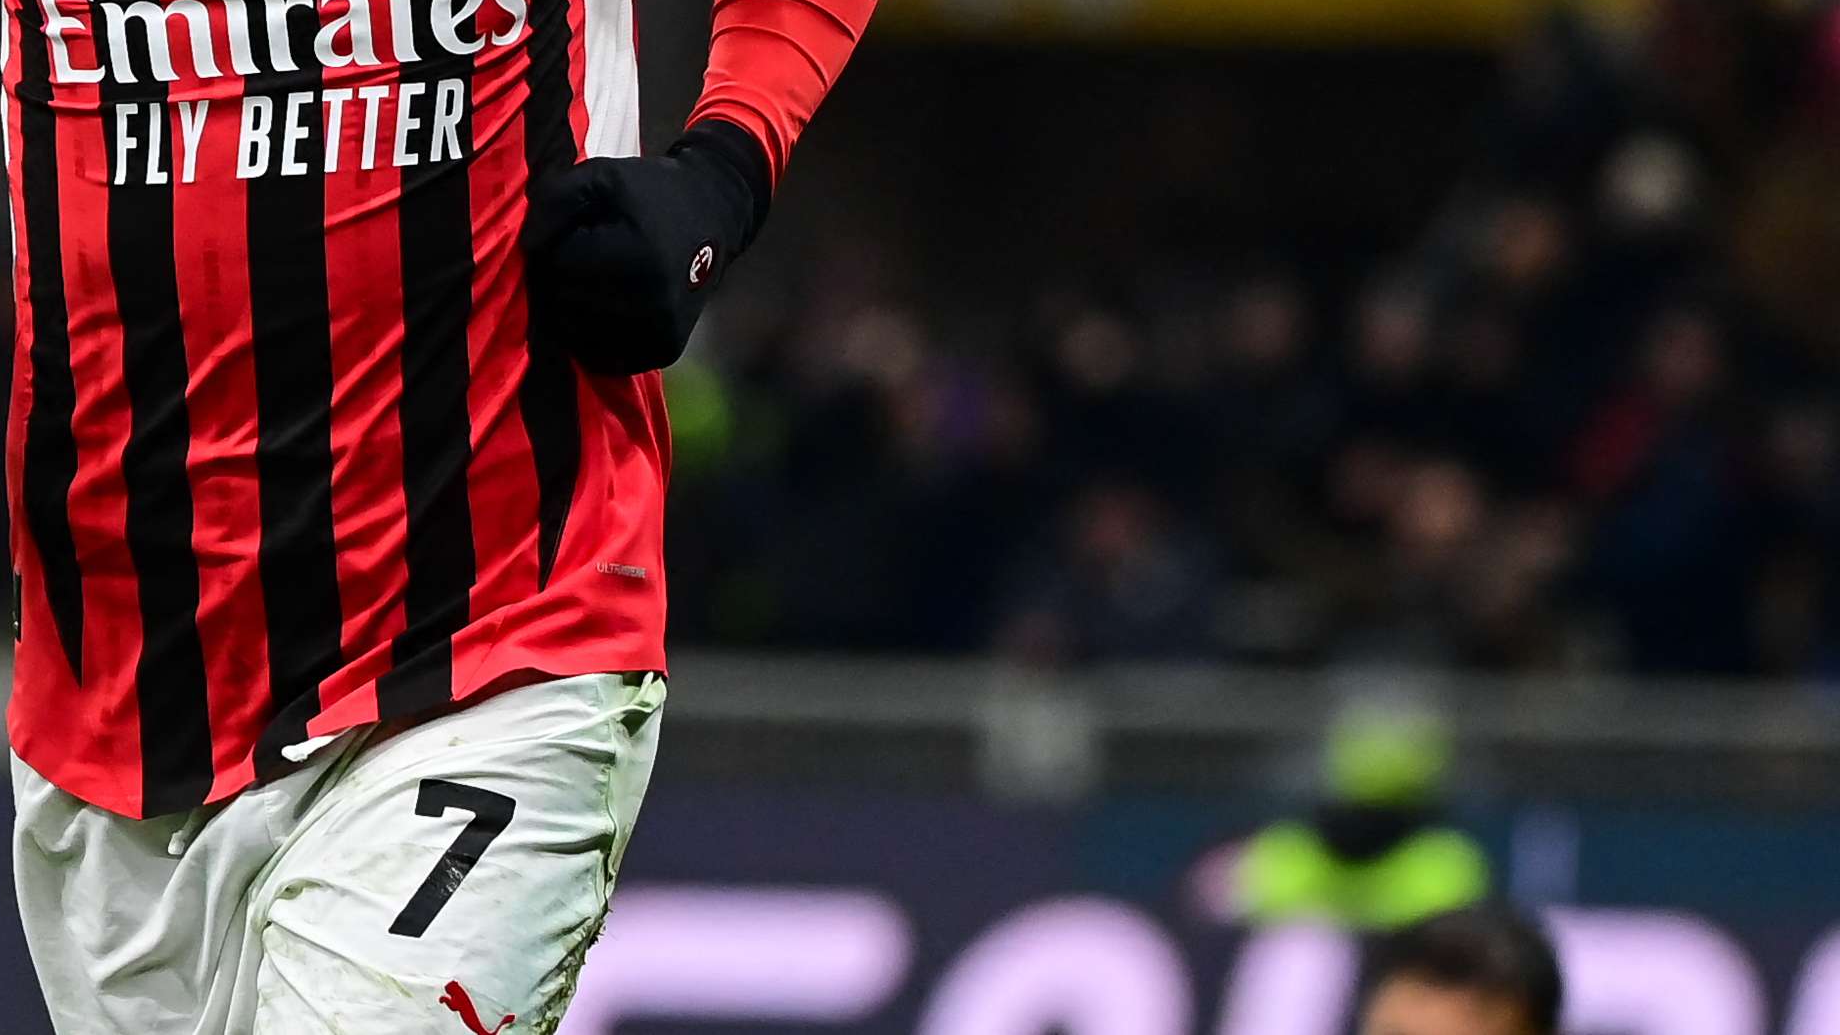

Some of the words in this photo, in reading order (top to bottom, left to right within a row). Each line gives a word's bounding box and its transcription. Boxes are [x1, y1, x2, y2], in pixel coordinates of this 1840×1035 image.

[113, 99, 210, 186] FLY
[235, 78, 465, 179] BETTER
[388, 778, 517, 938] 7
